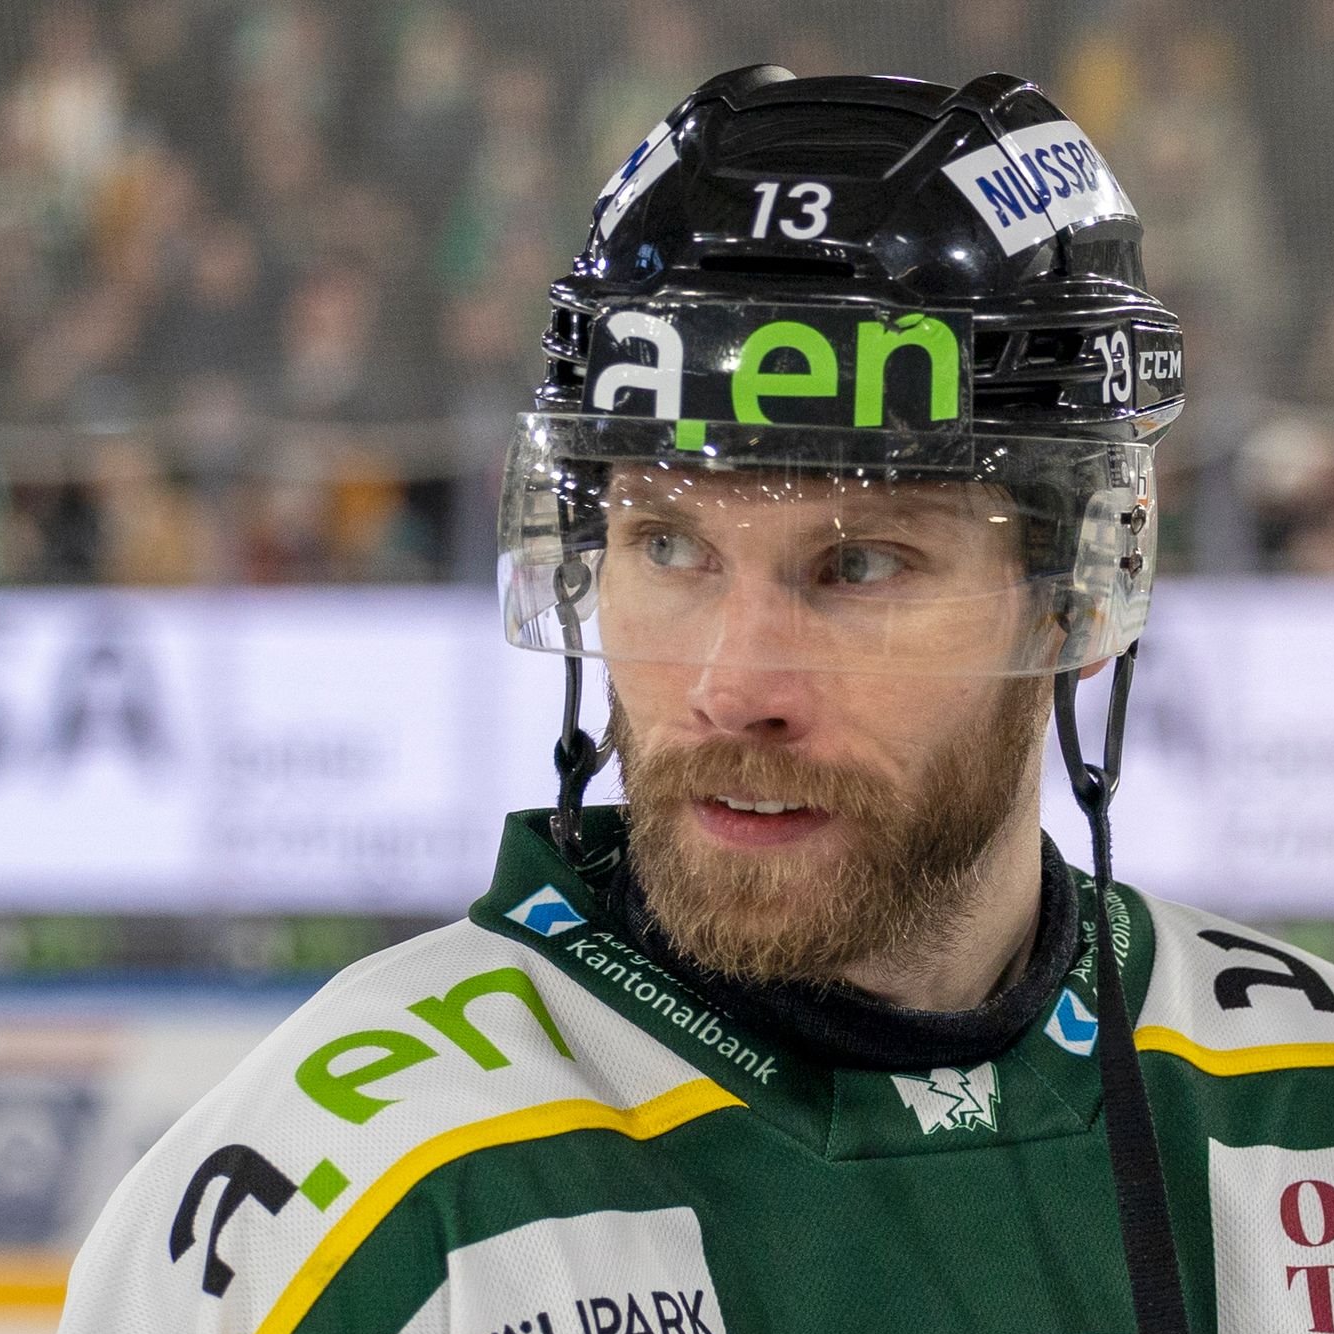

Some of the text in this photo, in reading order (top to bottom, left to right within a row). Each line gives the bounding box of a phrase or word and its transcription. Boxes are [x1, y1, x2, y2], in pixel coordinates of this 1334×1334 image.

[750, 182, 833, 240] 13
[1094, 330, 1132, 404] 13
[1139, 350, 1182, 380] CCM
[565, 938, 778, 1085] Kantonalbank
[169, 966, 576, 1298] a.en
